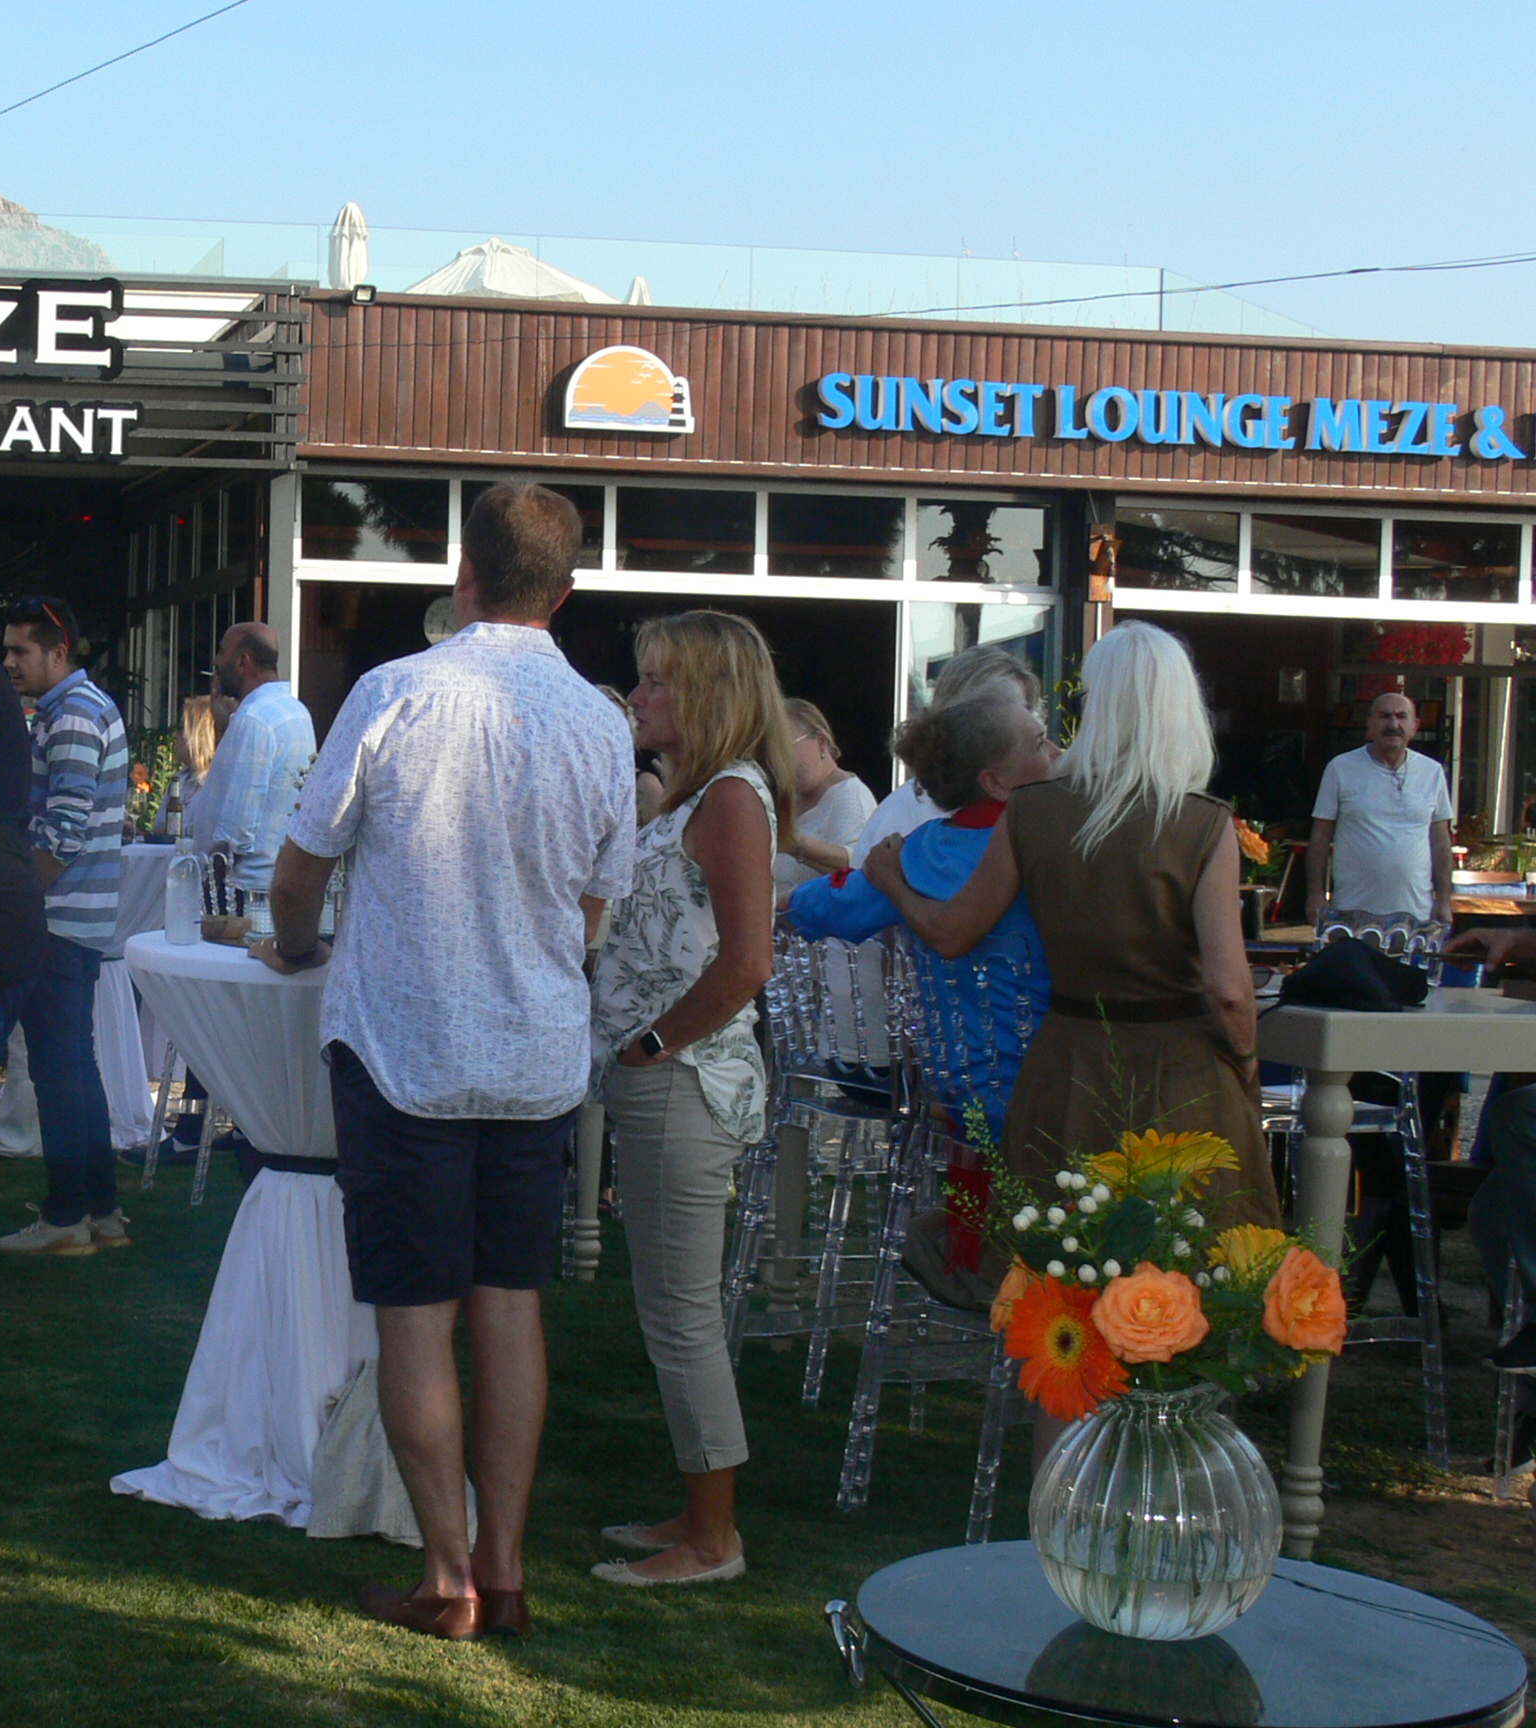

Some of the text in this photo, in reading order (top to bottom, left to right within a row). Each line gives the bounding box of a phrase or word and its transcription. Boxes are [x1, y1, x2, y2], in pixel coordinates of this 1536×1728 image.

[817, 371, 1527, 459] SUNSET LOUNGE MEZE &
